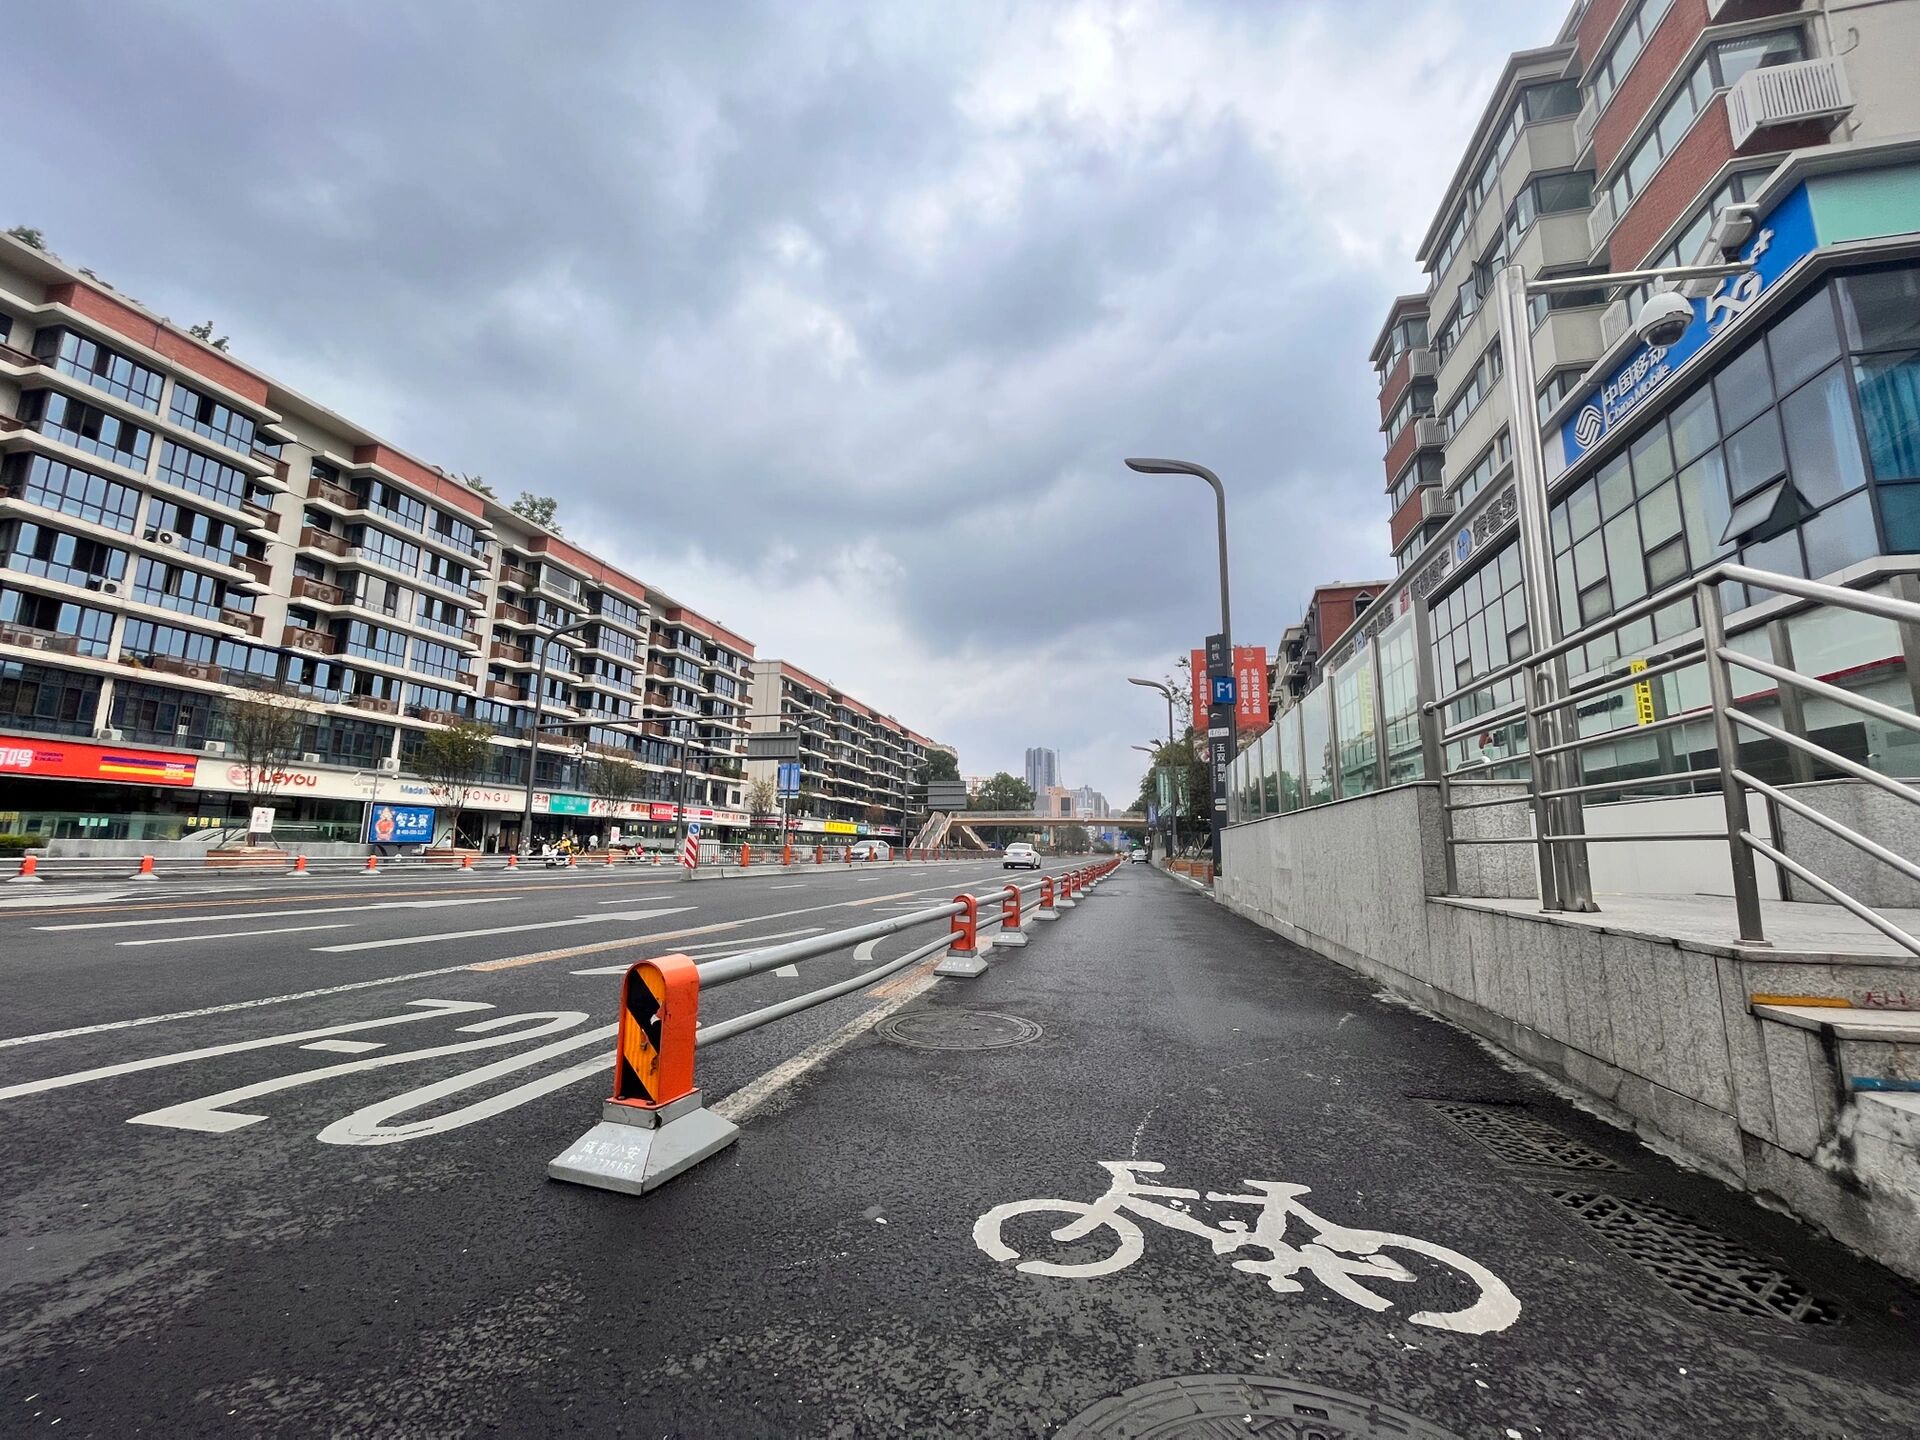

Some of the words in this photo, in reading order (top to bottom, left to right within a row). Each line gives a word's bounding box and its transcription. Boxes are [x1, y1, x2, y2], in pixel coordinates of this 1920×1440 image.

[1604, 346, 1668, 407] 中国移动
[1608, 395, 1635, 425] China
[1635, 362, 1671, 402] Mobile
[1216, 682, 1233, 699] F1
[259, 770, 317, 787] Leyou
[464, 787, 511, 803] HONGU
